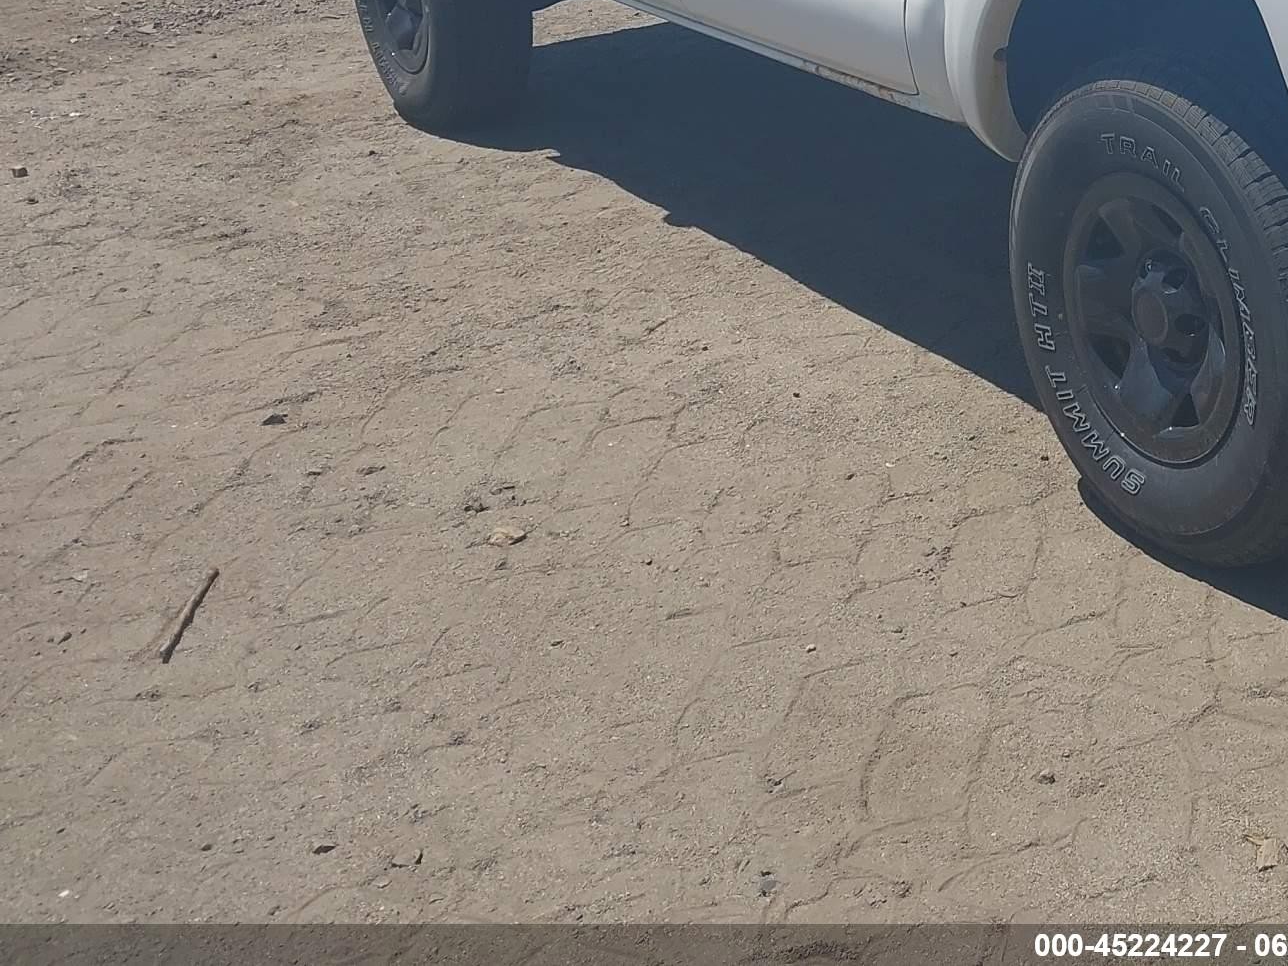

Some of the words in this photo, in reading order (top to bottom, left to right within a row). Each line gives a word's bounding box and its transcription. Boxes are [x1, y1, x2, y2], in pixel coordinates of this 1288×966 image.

[1100, 132, 1187, 194] TRAIL
[1200, 206, 1259, 427] CLIMBER
[1044, 364, 1147, 497] SUMMIT
